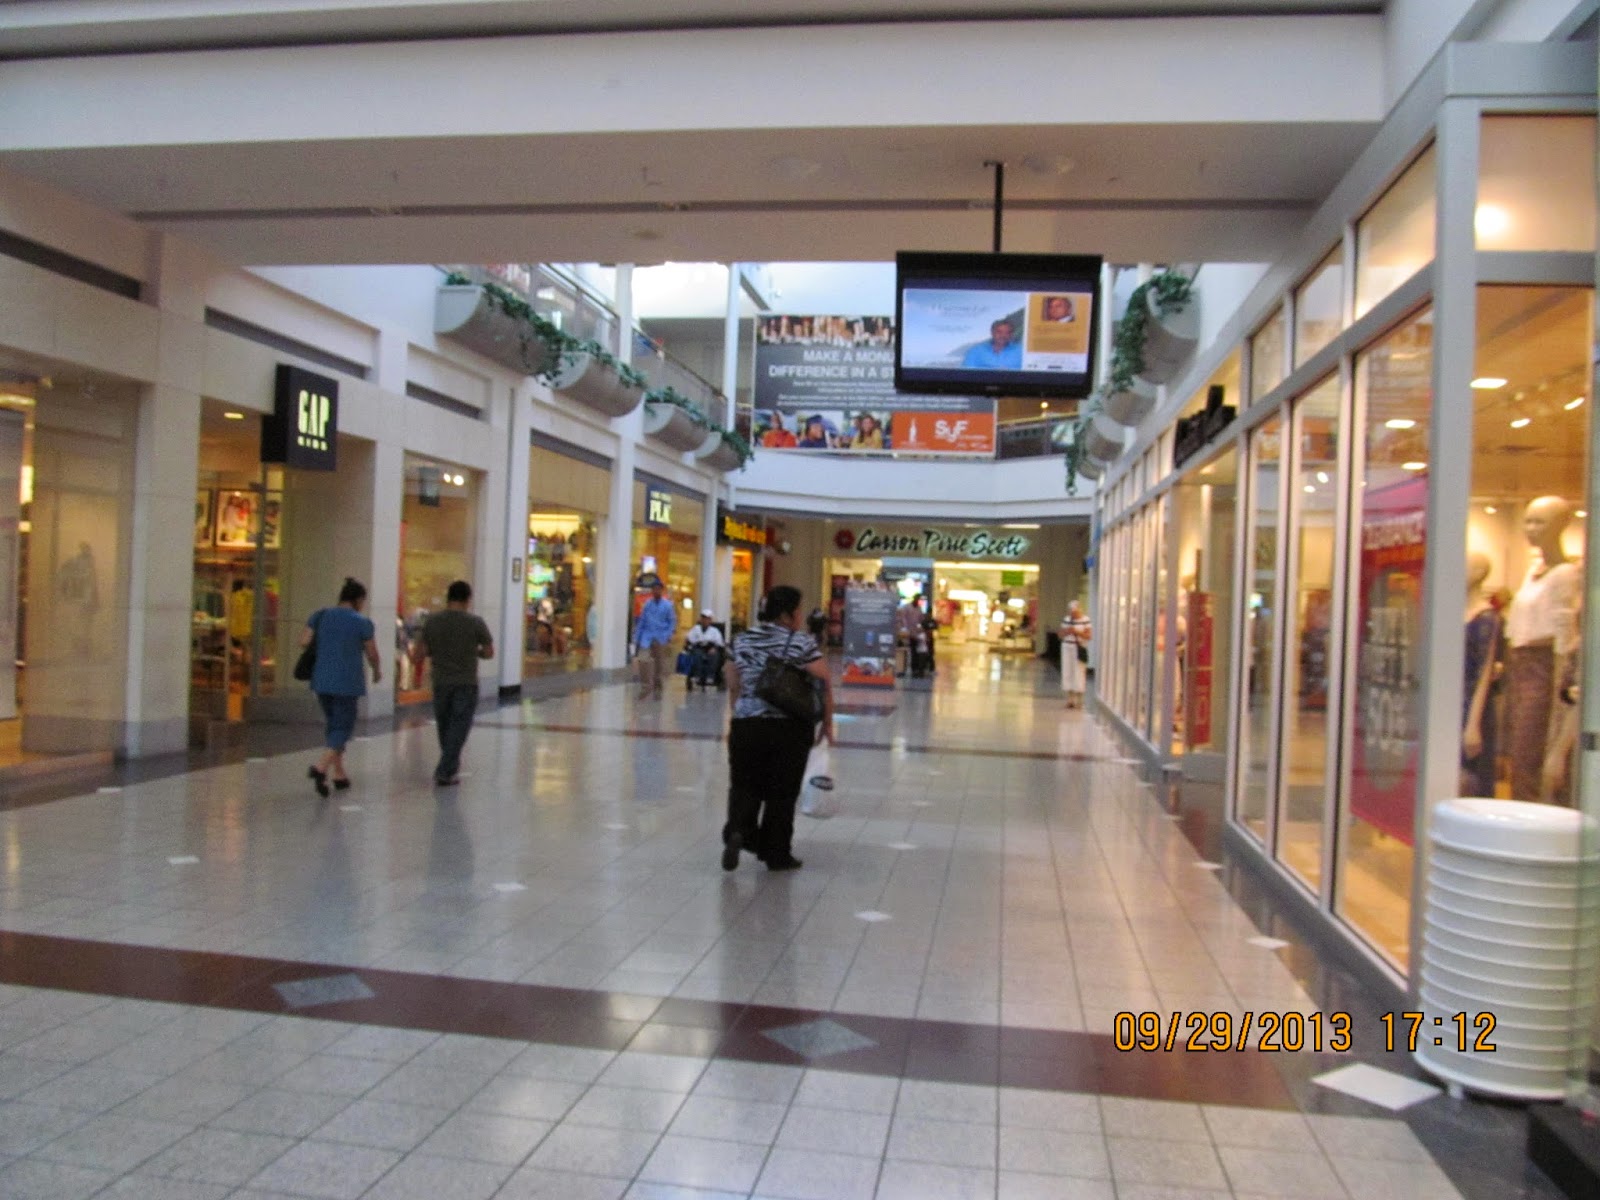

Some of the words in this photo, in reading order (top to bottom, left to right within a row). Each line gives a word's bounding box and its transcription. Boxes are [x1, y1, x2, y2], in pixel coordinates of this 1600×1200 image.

[803, 350, 840, 361] MAKE
[842, 350, 853, 361] A
[767, 364, 849, 378] DIFFERENCE
[851, 365, 865, 378] IN
[867, 366, 878, 379] A
[298, 389, 330, 438] GAP
[969, 532, 1023, 556] Scott
